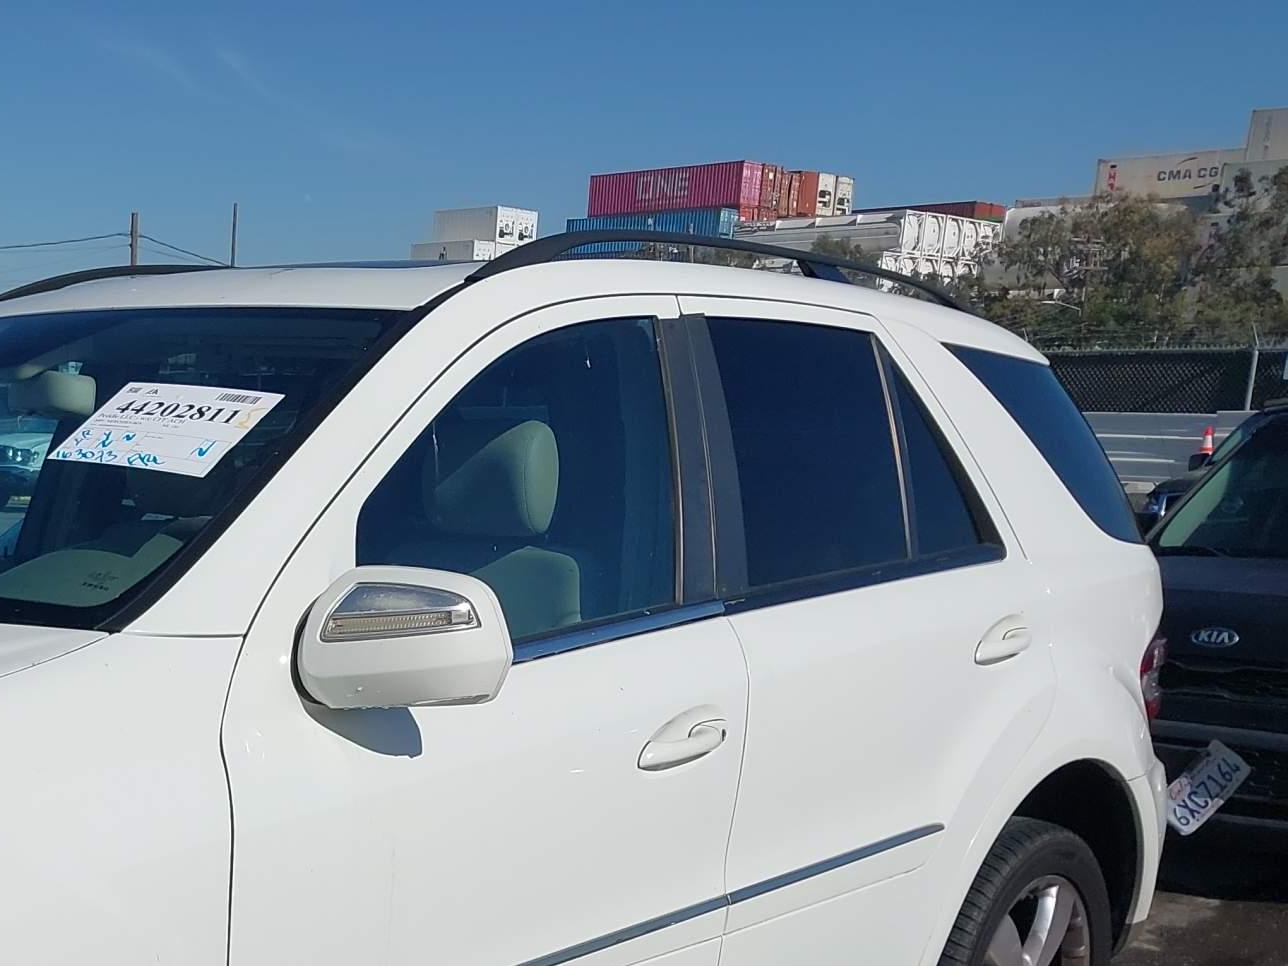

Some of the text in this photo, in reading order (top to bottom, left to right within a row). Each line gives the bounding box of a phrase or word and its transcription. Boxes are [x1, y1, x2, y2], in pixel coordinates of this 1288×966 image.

[636, 170, 690, 200] ONE
[1157, 168, 1192, 181] CMA
[116, 399, 241, 425] 44202811
[1198, 630, 1229, 643] KIA
[1173, 757, 1241, 827] 6XCZ164
